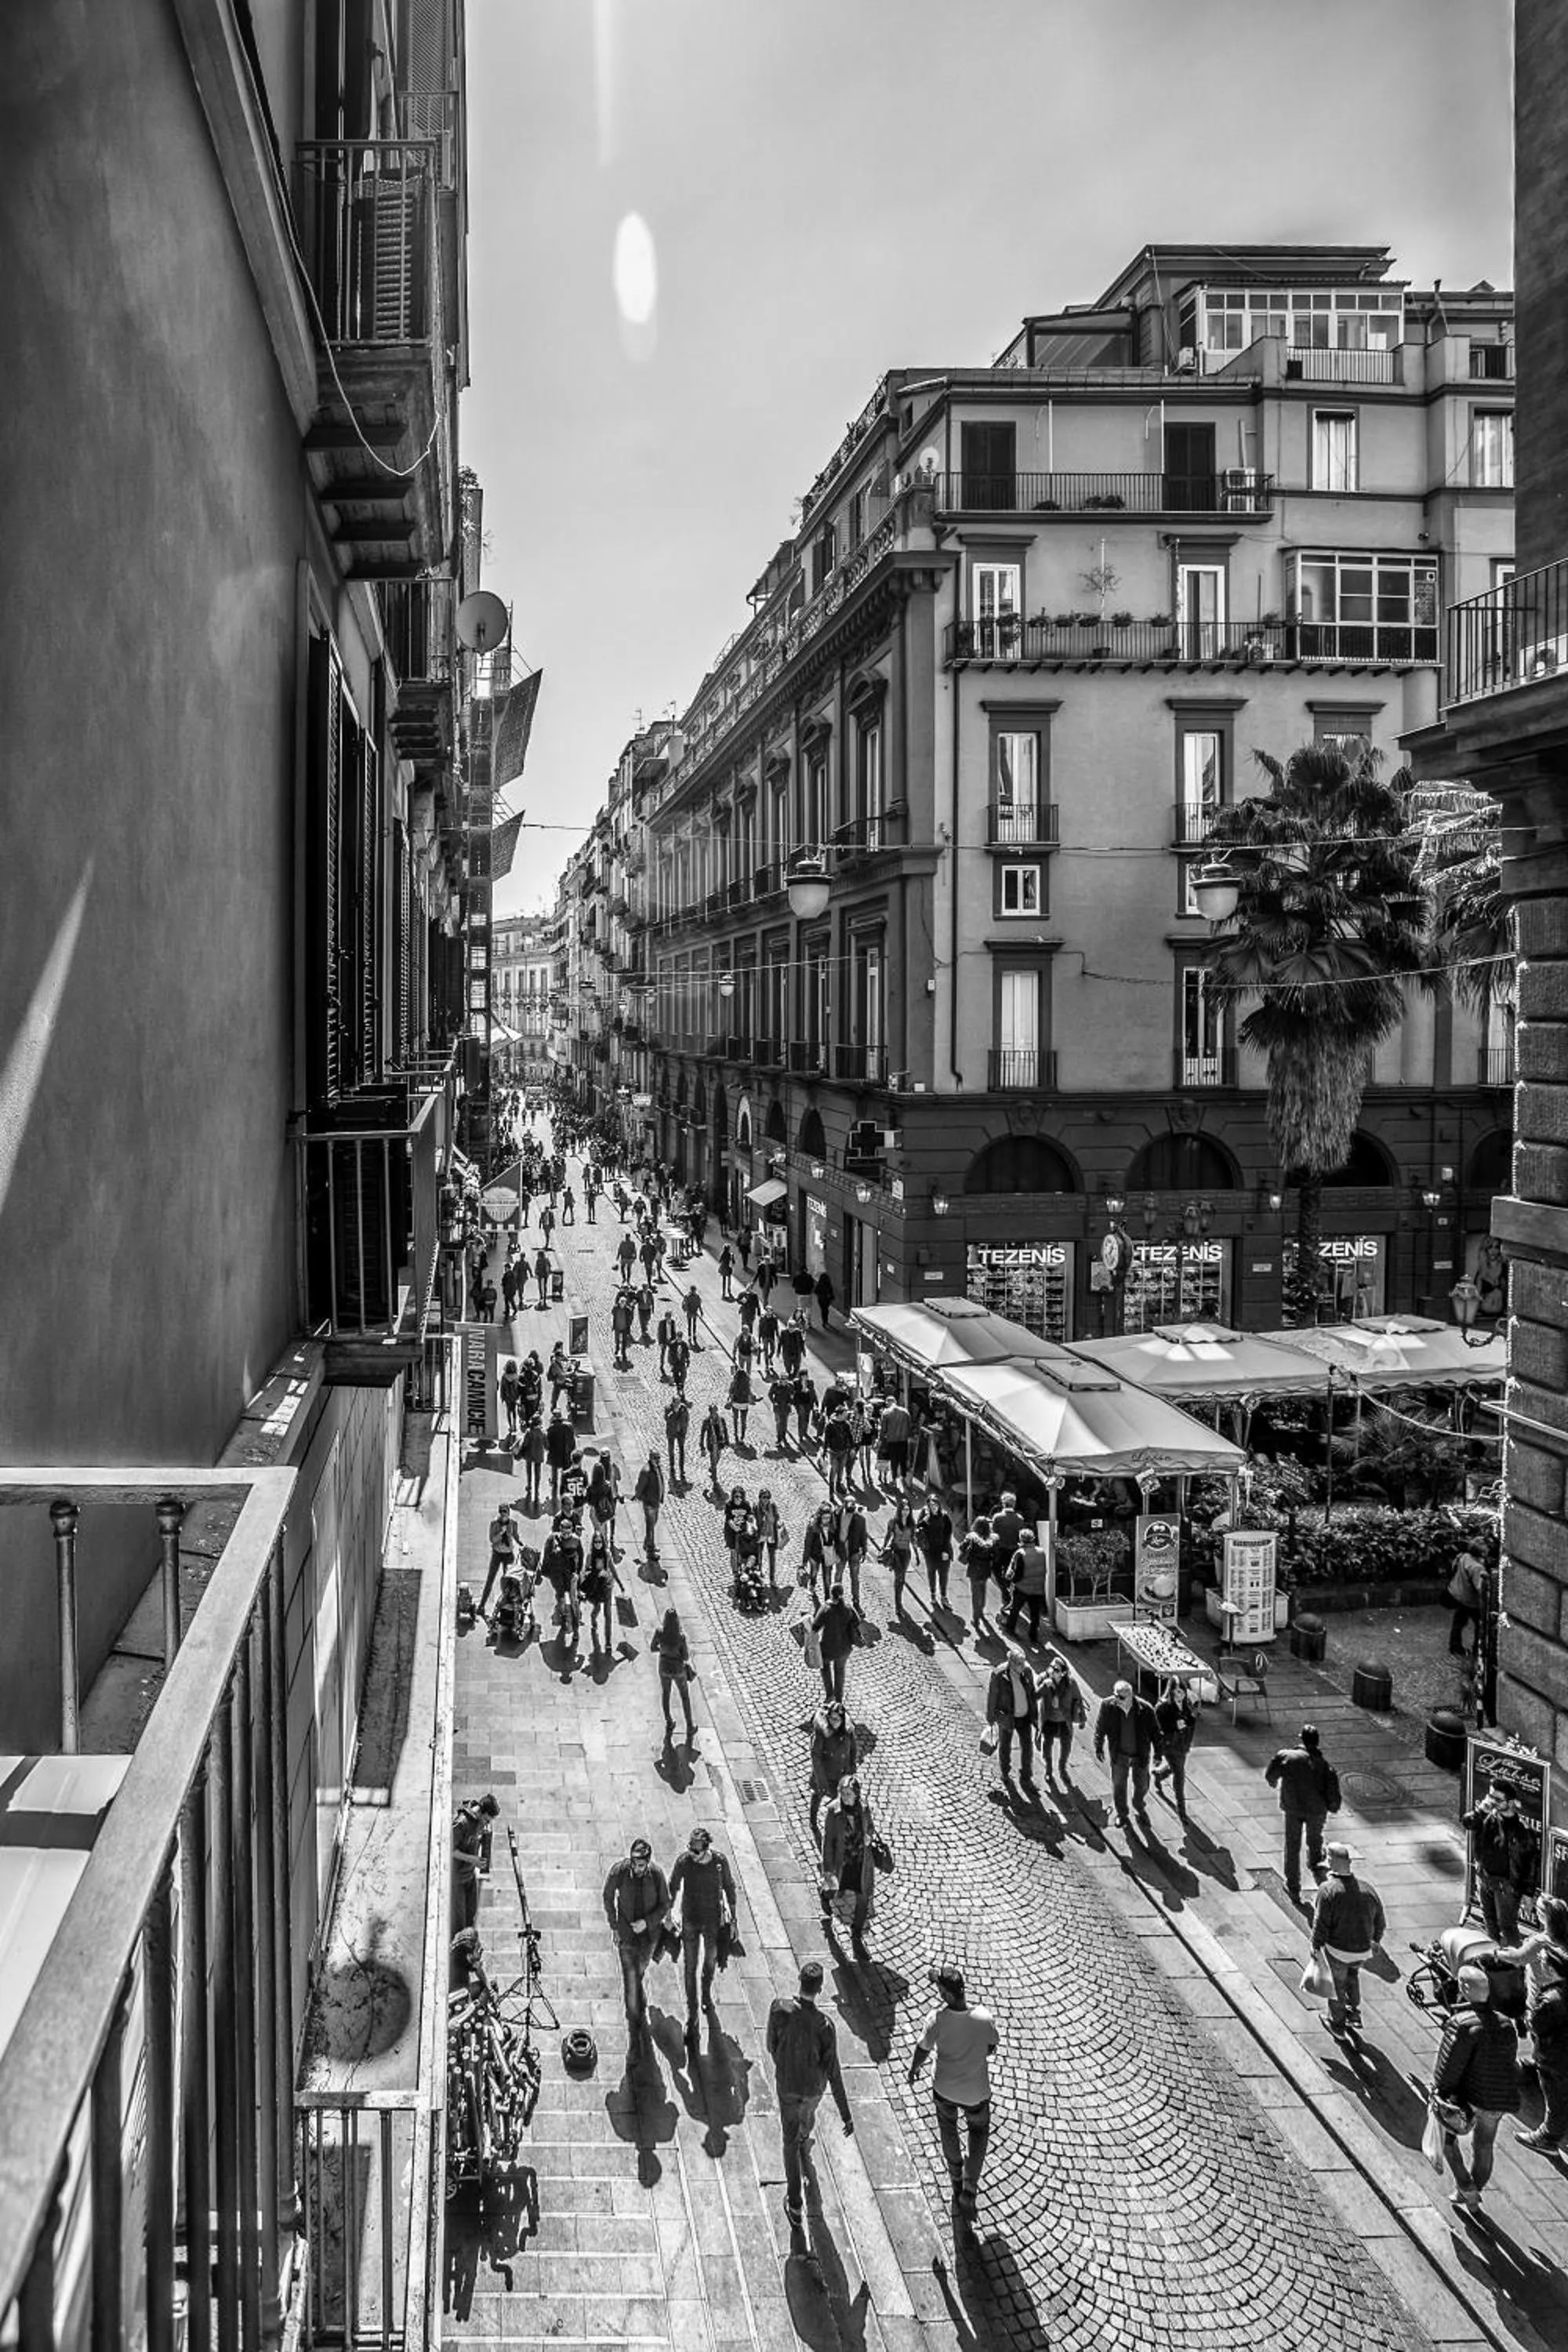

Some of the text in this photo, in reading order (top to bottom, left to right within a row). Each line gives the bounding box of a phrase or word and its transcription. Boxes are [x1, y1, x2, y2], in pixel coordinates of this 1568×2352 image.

[978, 1245, 1065, 1264] TEZENIS
[1294, 1236, 1377, 1257] ZENIS
[467, 1329, 486, 1434] NARA CAMICIE
